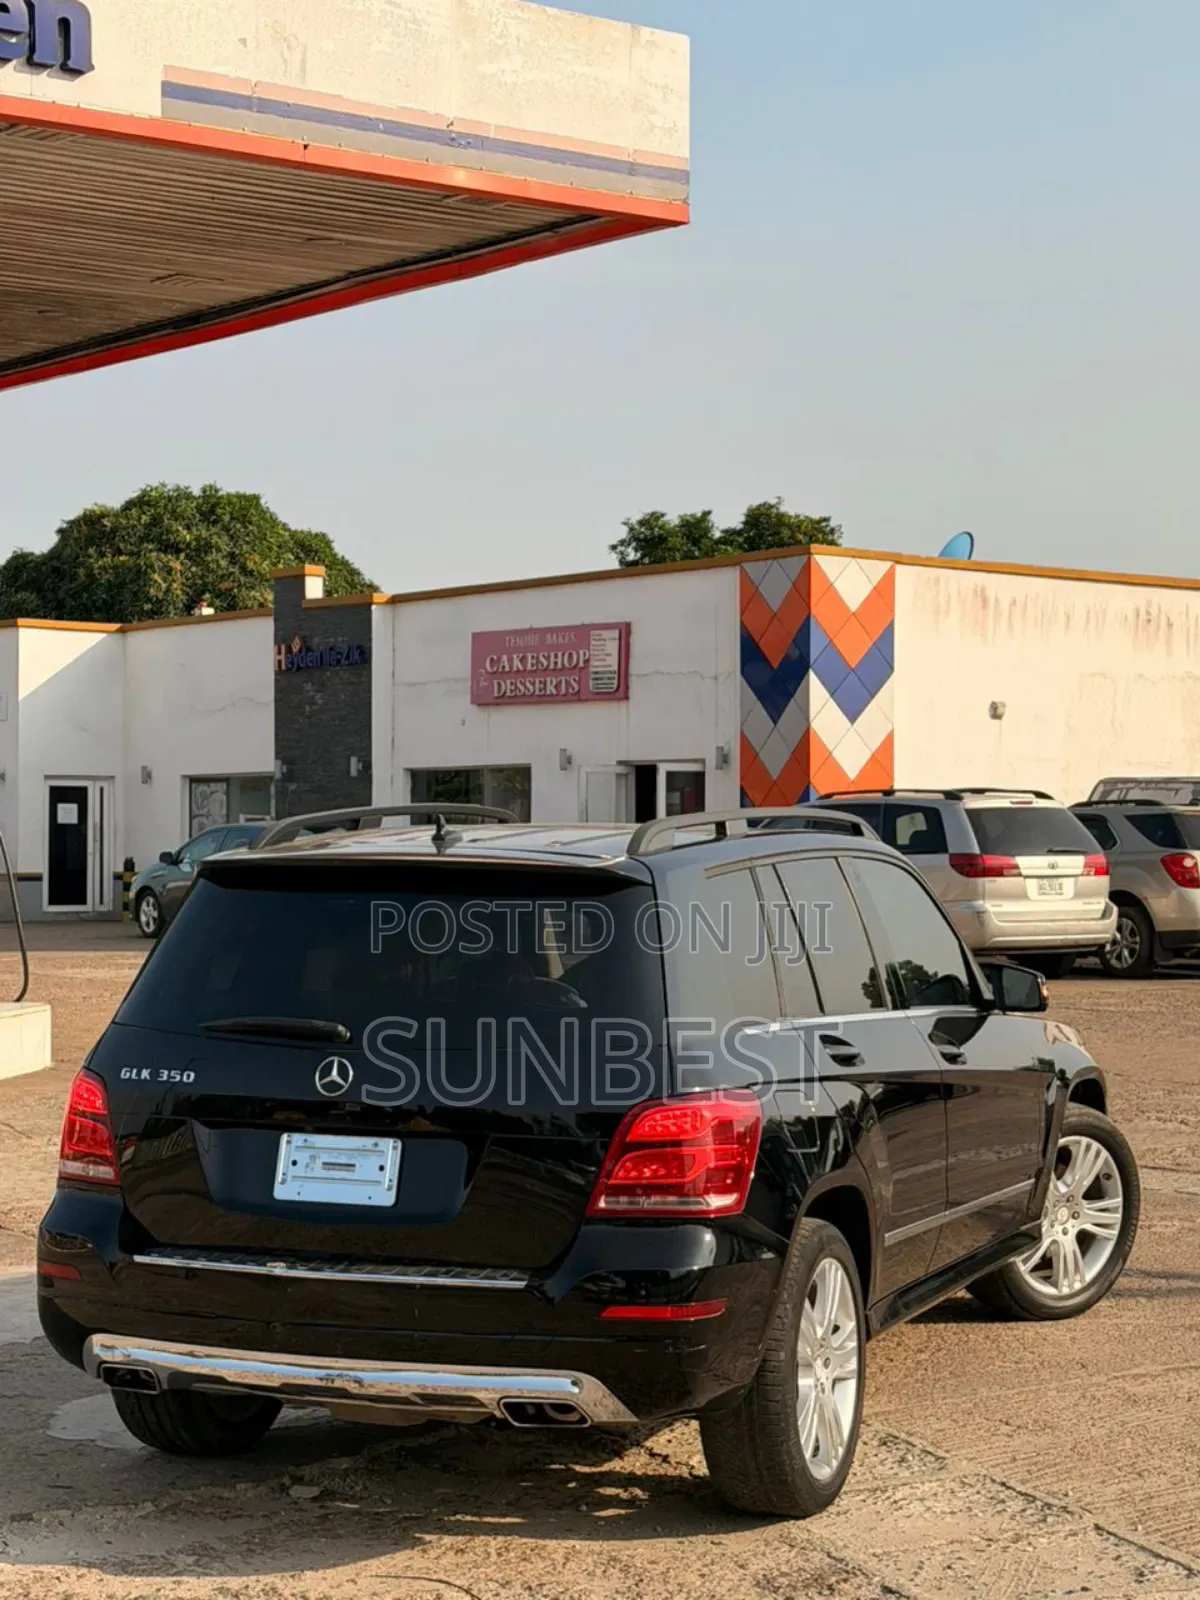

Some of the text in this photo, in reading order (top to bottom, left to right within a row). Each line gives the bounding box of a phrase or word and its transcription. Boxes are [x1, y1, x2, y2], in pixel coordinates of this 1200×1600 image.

[485, 648, 590, 674] CAKESHOP
[493, 674, 580, 699] DESSERTS
[119, 1066, 196, 1084] GLK 350
